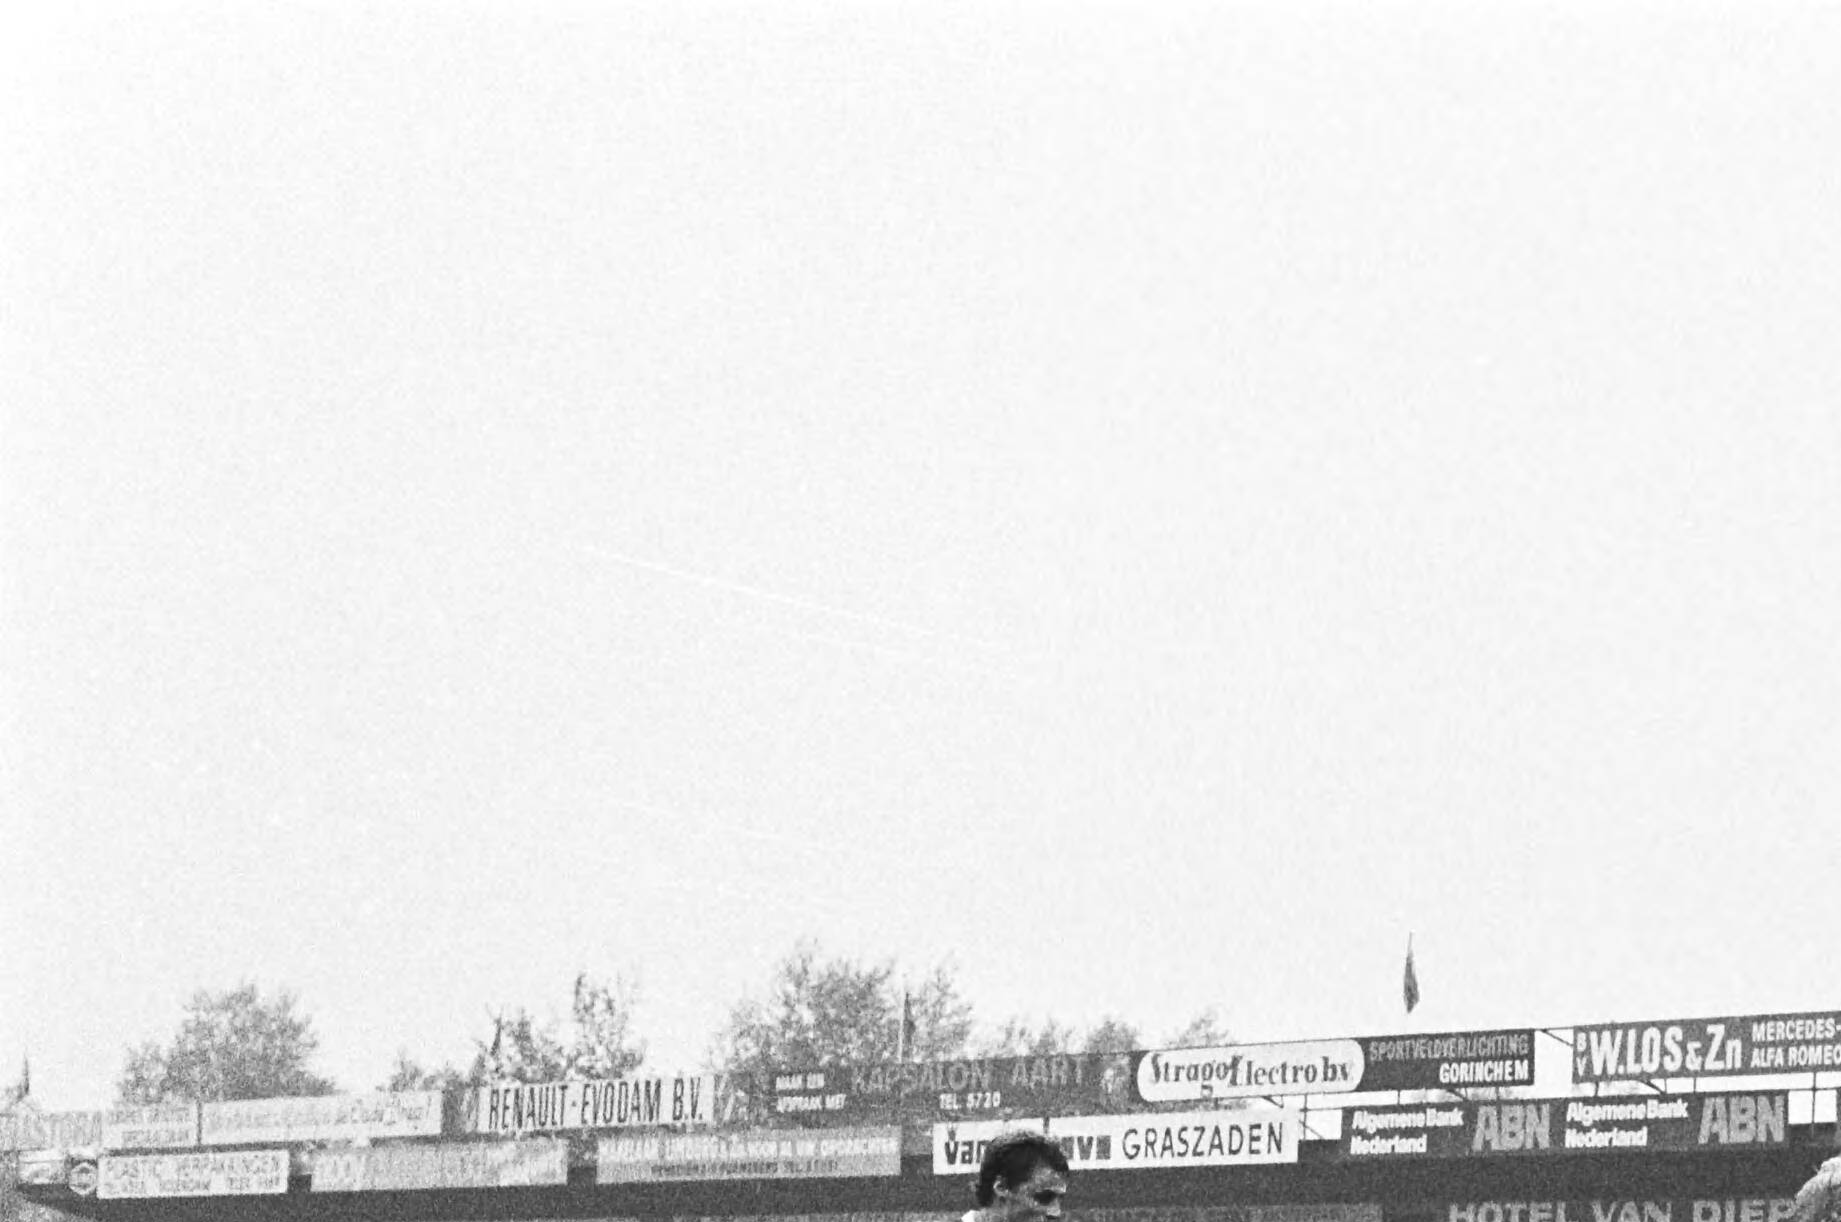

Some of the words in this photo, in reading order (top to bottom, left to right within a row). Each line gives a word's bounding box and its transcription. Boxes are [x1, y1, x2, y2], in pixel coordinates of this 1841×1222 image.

[1751, 1047, 1783, 1067] ALFA
[1439, 1059, 1529, 1083] GORINCHEM
[1426, 1108, 1464, 1126] Bank
[1647, 1099, 1689, 1120] Bank
[1699, 1096, 1784, 1143] ABN
[1473, 1103, 1550, 1151] ABN
[1122, 1122, 1283, 1160] GRASZADEN
[1350, 1135, 1427, 1154] Nederland
[1565, 1128, 1648, 1148] Nederland
